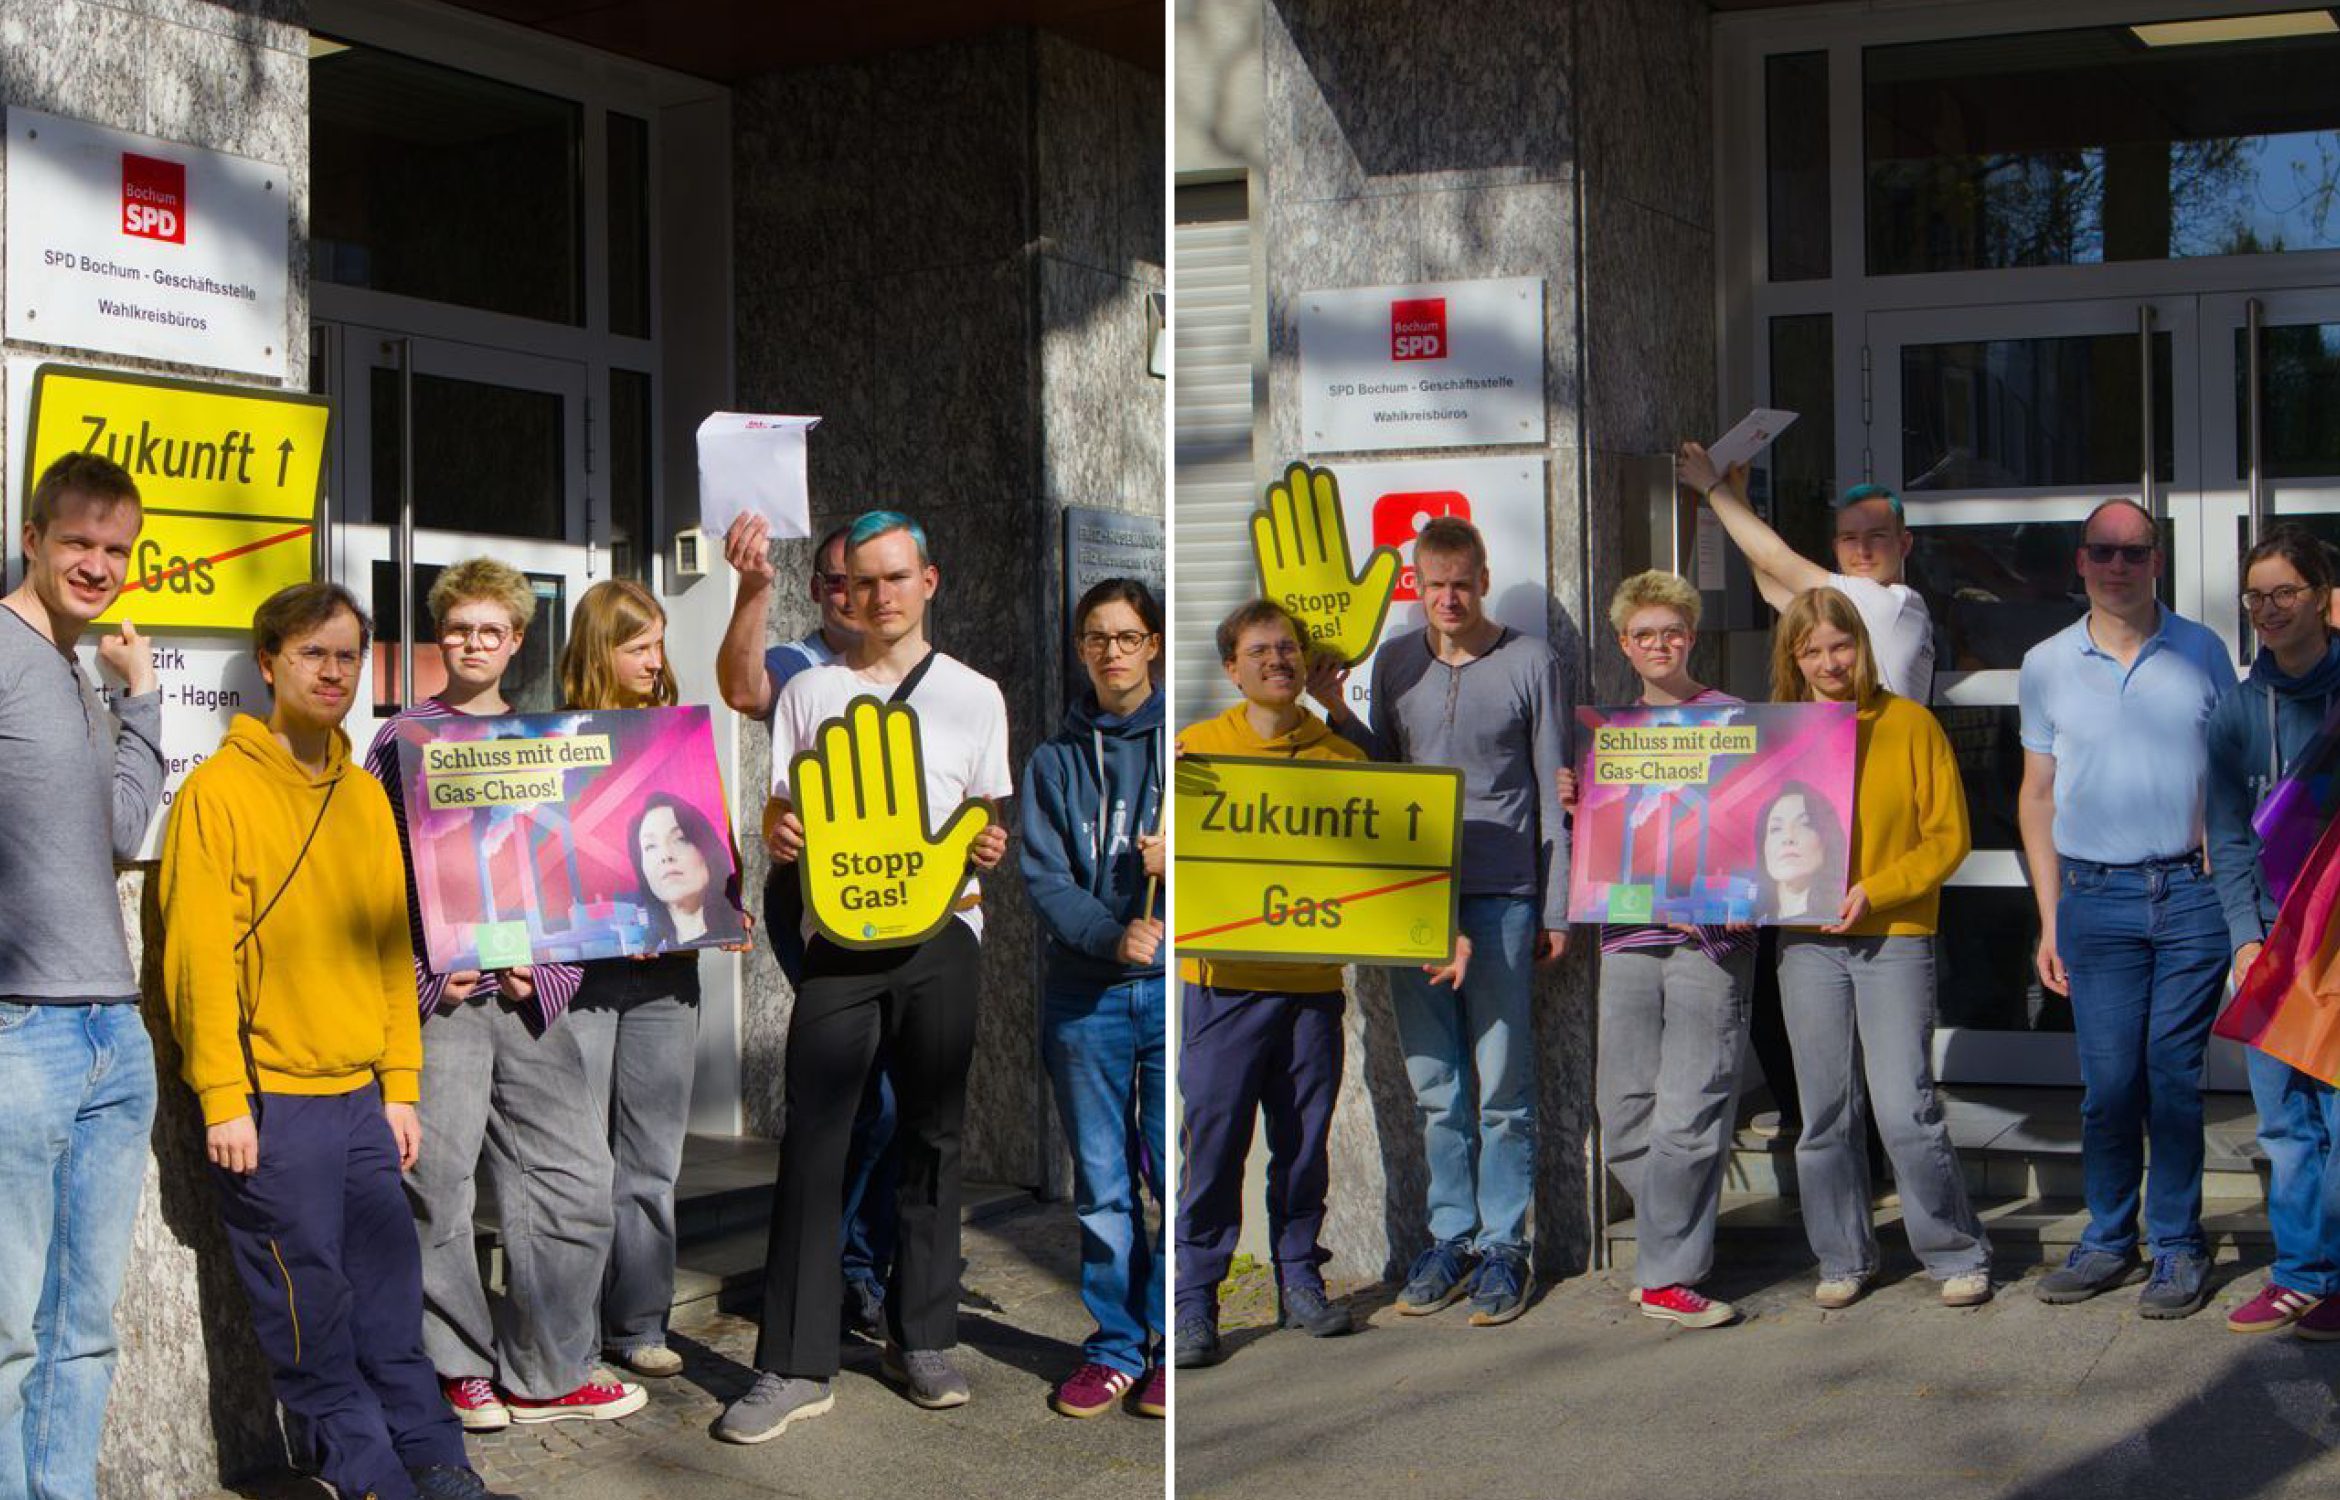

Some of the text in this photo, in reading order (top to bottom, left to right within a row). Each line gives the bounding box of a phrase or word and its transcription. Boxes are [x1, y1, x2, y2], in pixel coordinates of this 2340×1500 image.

[126, 182, 176, 205] Bochum
[125, 204, 177, 237] SPD
[44, 250, 76, 269] SPD
[80, 255, 141, 281] Bochum
[153, 269, 257, 301] Geschäftsstelle
[98, 298, 208, 331] Wahlkreisbüros
[1395, 320, 1439, 333] Bochum
[1395, 335, 1439, 357] SPD
[1328, 383, 1355, 397] SPD
[1358, 382, 1409, 395] Bochum
[1418, 375, 1514, 393] Geschäftsstelle
[81, 415, 256, 485] Zukunft
[137, 539, 216, 596] Gas
[1285, 591, 1351, 615] Stopp
[1310, 616, 1343, 640] as!
[181, 683, 240, 712] Hagen
[1599, 730, 1751, 751] Schluss mit dem
[429, 741, 606, 770] Schluss mit dem
[1600, 761, 1704, 781] Gas-Chaos!
[434, 777, 558, 805] Gas-Chaos!
[1201, 790, 1380, 840] Zukunft
[831, 850, 924, 880] Stopp
[839, 882, 908, 911] Gas!
[1262, 884, 1342, 929] Gas
